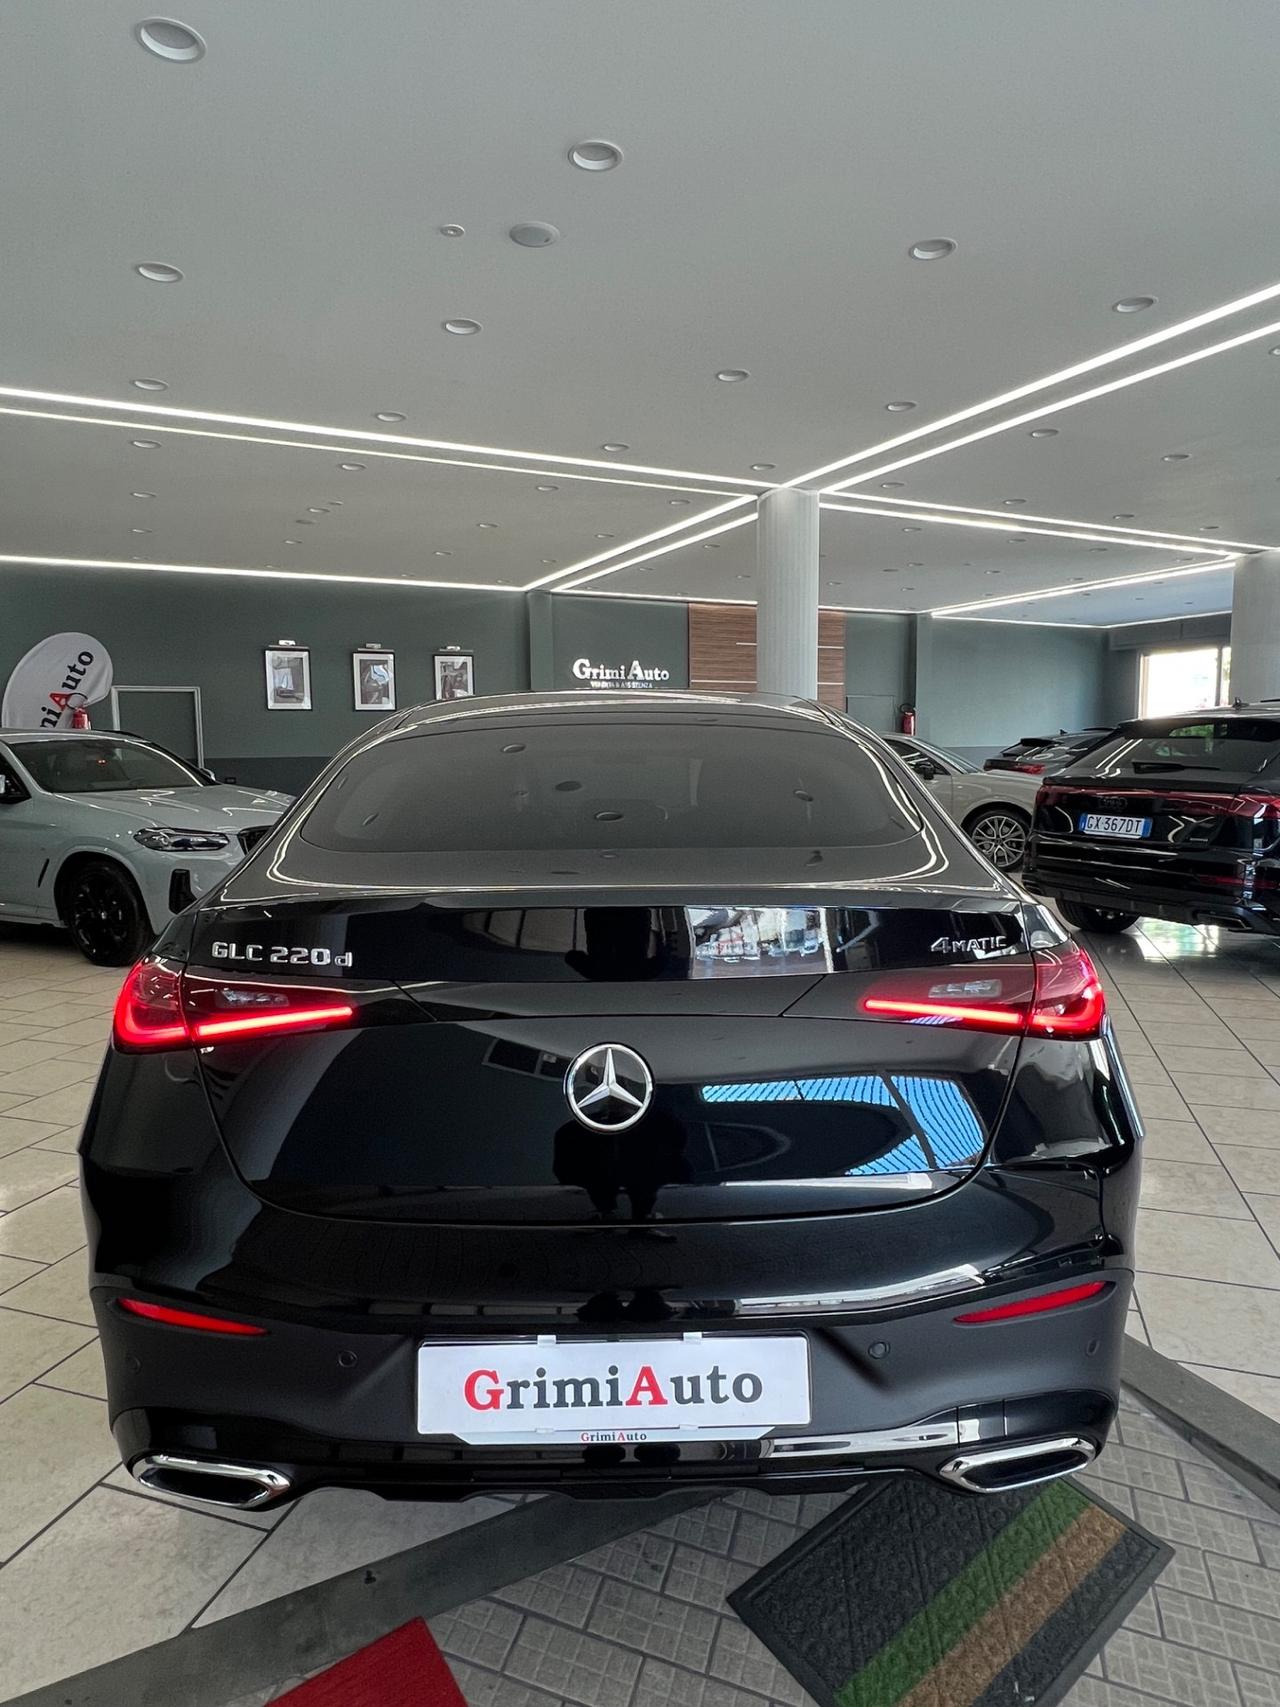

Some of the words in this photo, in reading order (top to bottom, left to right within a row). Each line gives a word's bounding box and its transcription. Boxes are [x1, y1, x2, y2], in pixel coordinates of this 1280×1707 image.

[211, 941, 263, 961] GLC
[931, 935, 1006, 953] 4MATIC
[464, 1365, 763, 1411] GrimiAuto
[581, 1431, 647, 1441] GrimiAuto
